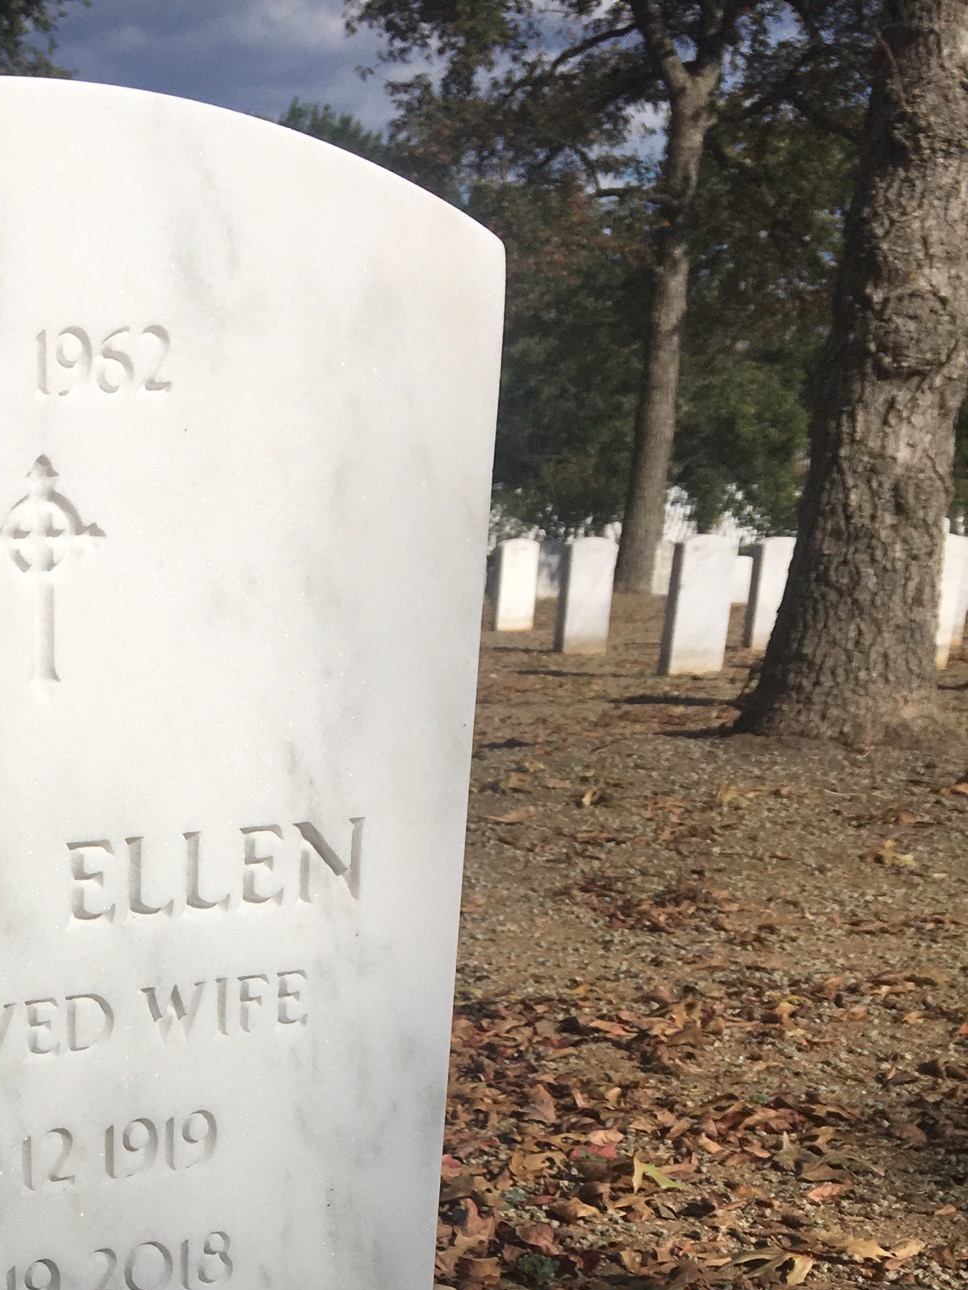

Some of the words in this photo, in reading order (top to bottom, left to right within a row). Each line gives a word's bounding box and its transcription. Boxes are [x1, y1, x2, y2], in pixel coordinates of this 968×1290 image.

[35, 324, 172, 396] 1962
[66, 816, 365, 925] ELLEN
[140, 969, 309, 1044] WIFE
[22, 1127, 75, 1191] 12
[104, 1109, 217, 1180] 1919
